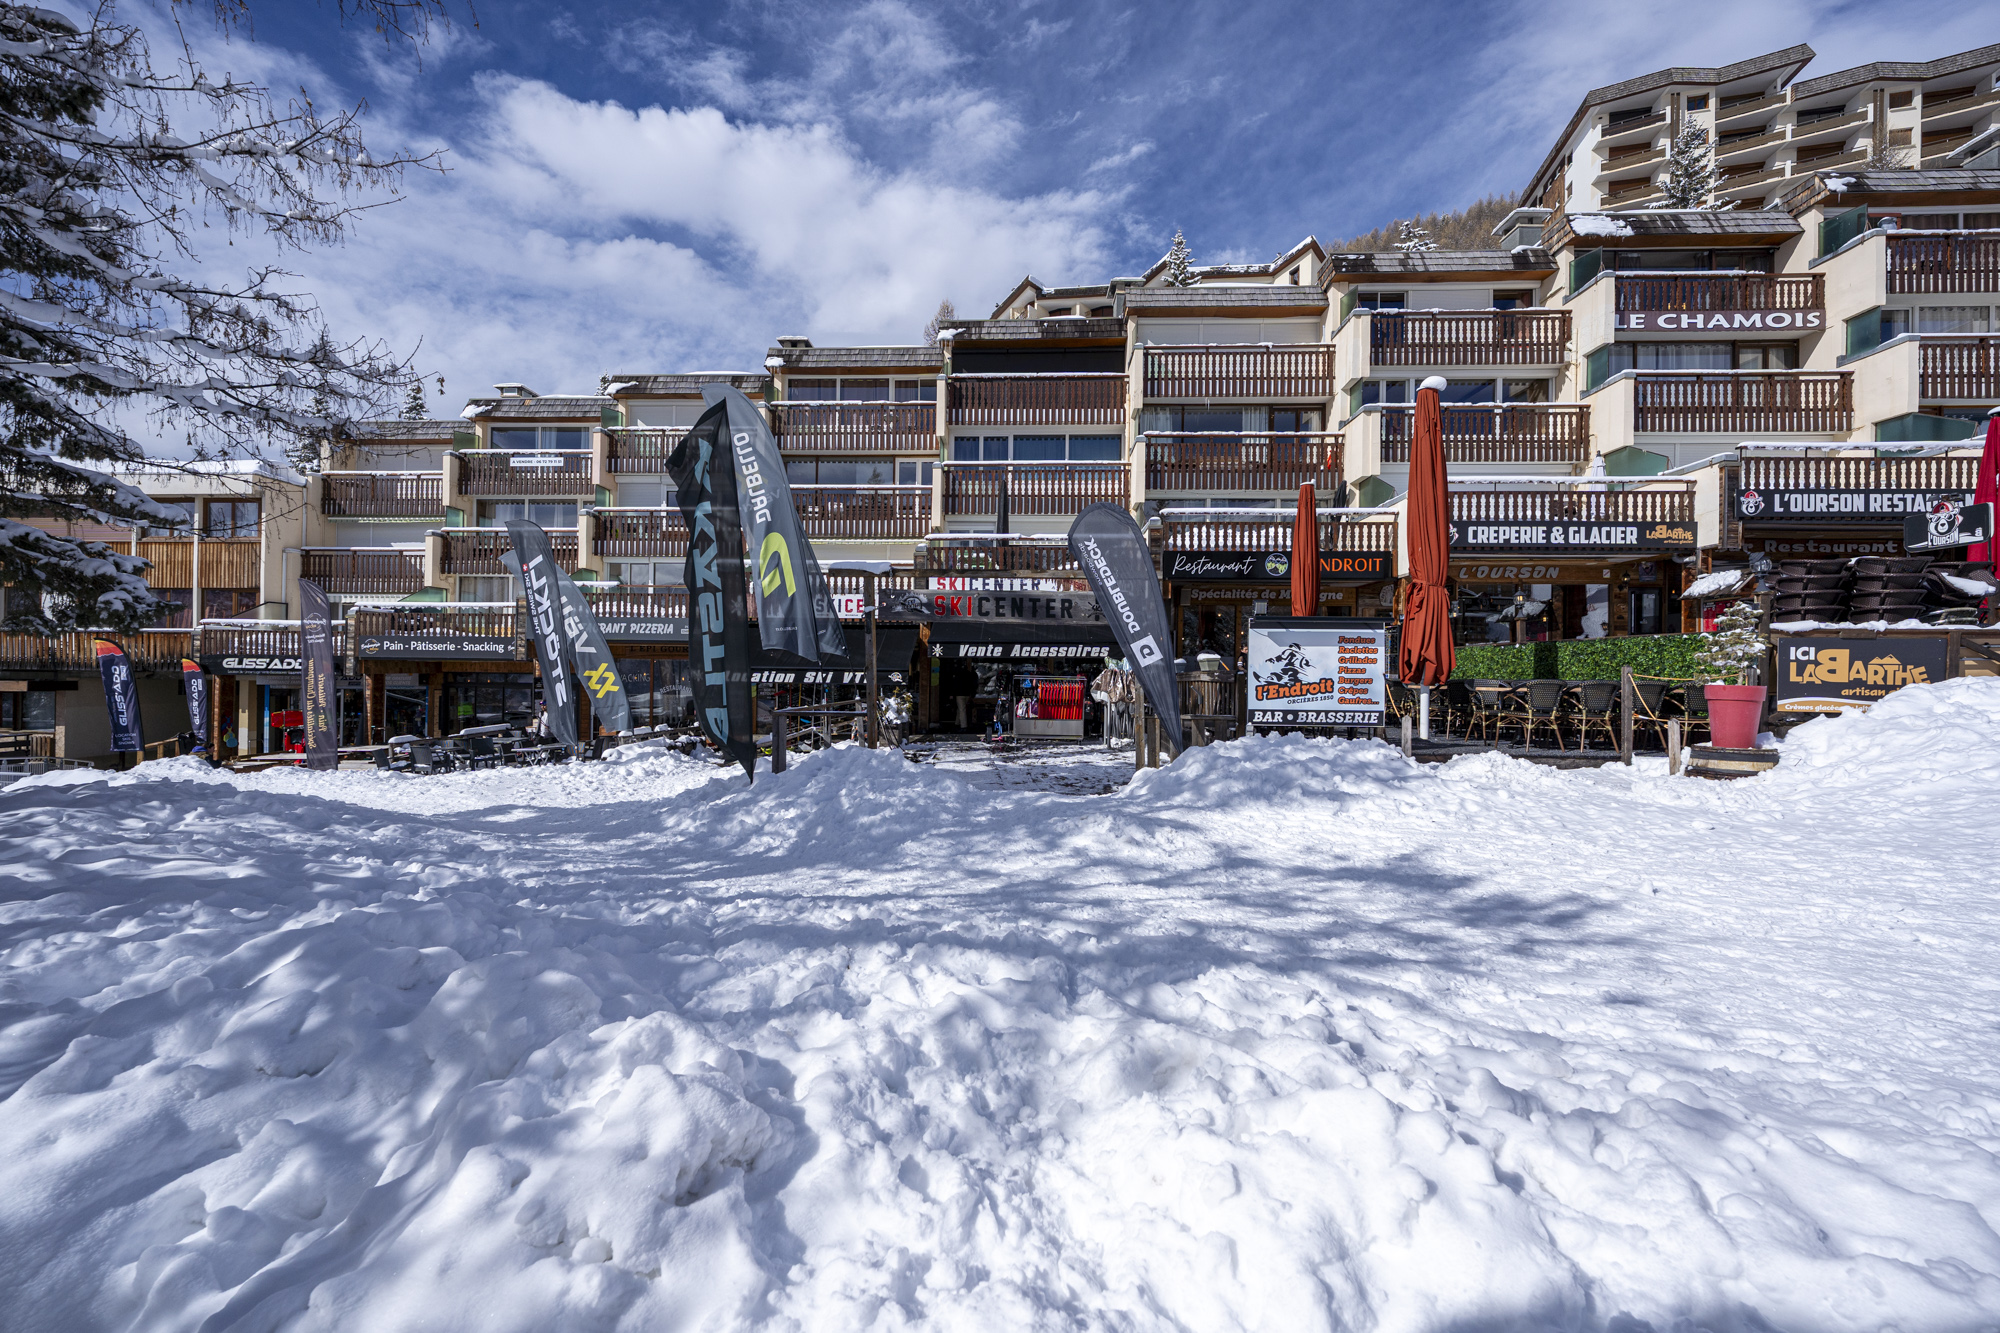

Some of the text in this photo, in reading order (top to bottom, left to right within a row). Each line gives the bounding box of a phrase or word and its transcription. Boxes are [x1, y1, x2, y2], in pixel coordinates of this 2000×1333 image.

[1615, 311, 1821, 329] LE CHAMOIS
[1773, 493, 1865, 513] L'OURSON
[1467, 526, 1638, 545] CREPERIE & GLACIER
[1764, 539, 1899, 554] Restaurant
[1172, 553, 1257, 575] Restaurant
[1459, 566, 1560, 579] L'OURSON
[1191, 588, 1259, 601] Spécialités
[1261, 588, 1276, 599] de
[629, 623, 674, 635] PIZZERIA
[1338, 636, 1376, 644] Fondues
[383, 641, 403, 650] Pain
[410, 641, 456, 651] Pâtisserie
[463, 641, 505, 653] Snacking
[959, 644, 1110, 657] Vente Accessoires
[1338, 646, 1378, 654] Raclettes
[1789, 646, 1816, 661] ICI
[1338, 656, 1378, 664] Grillades
[1338, 666, 1367, 674] Pizzas
[804, 671, 834, 683] Ski
[1338, 676, 1373, 686] Burgers
[111, 666, 128, 726] GLISS'ADD
[1255, 678, 1335, 701] l'Endroit
[1338, 686, 1369, 695] Crêpes
[1841, 687, 1885, 696] artisan
[191, 679, 200, 725] GLISS'ADD
[1287, 696, 1319, 705] ORCIÈRES
[1784, 703, 1814, 711] Crèmes
[1253, 711, 1380, 724] BAR BRASSERIE
